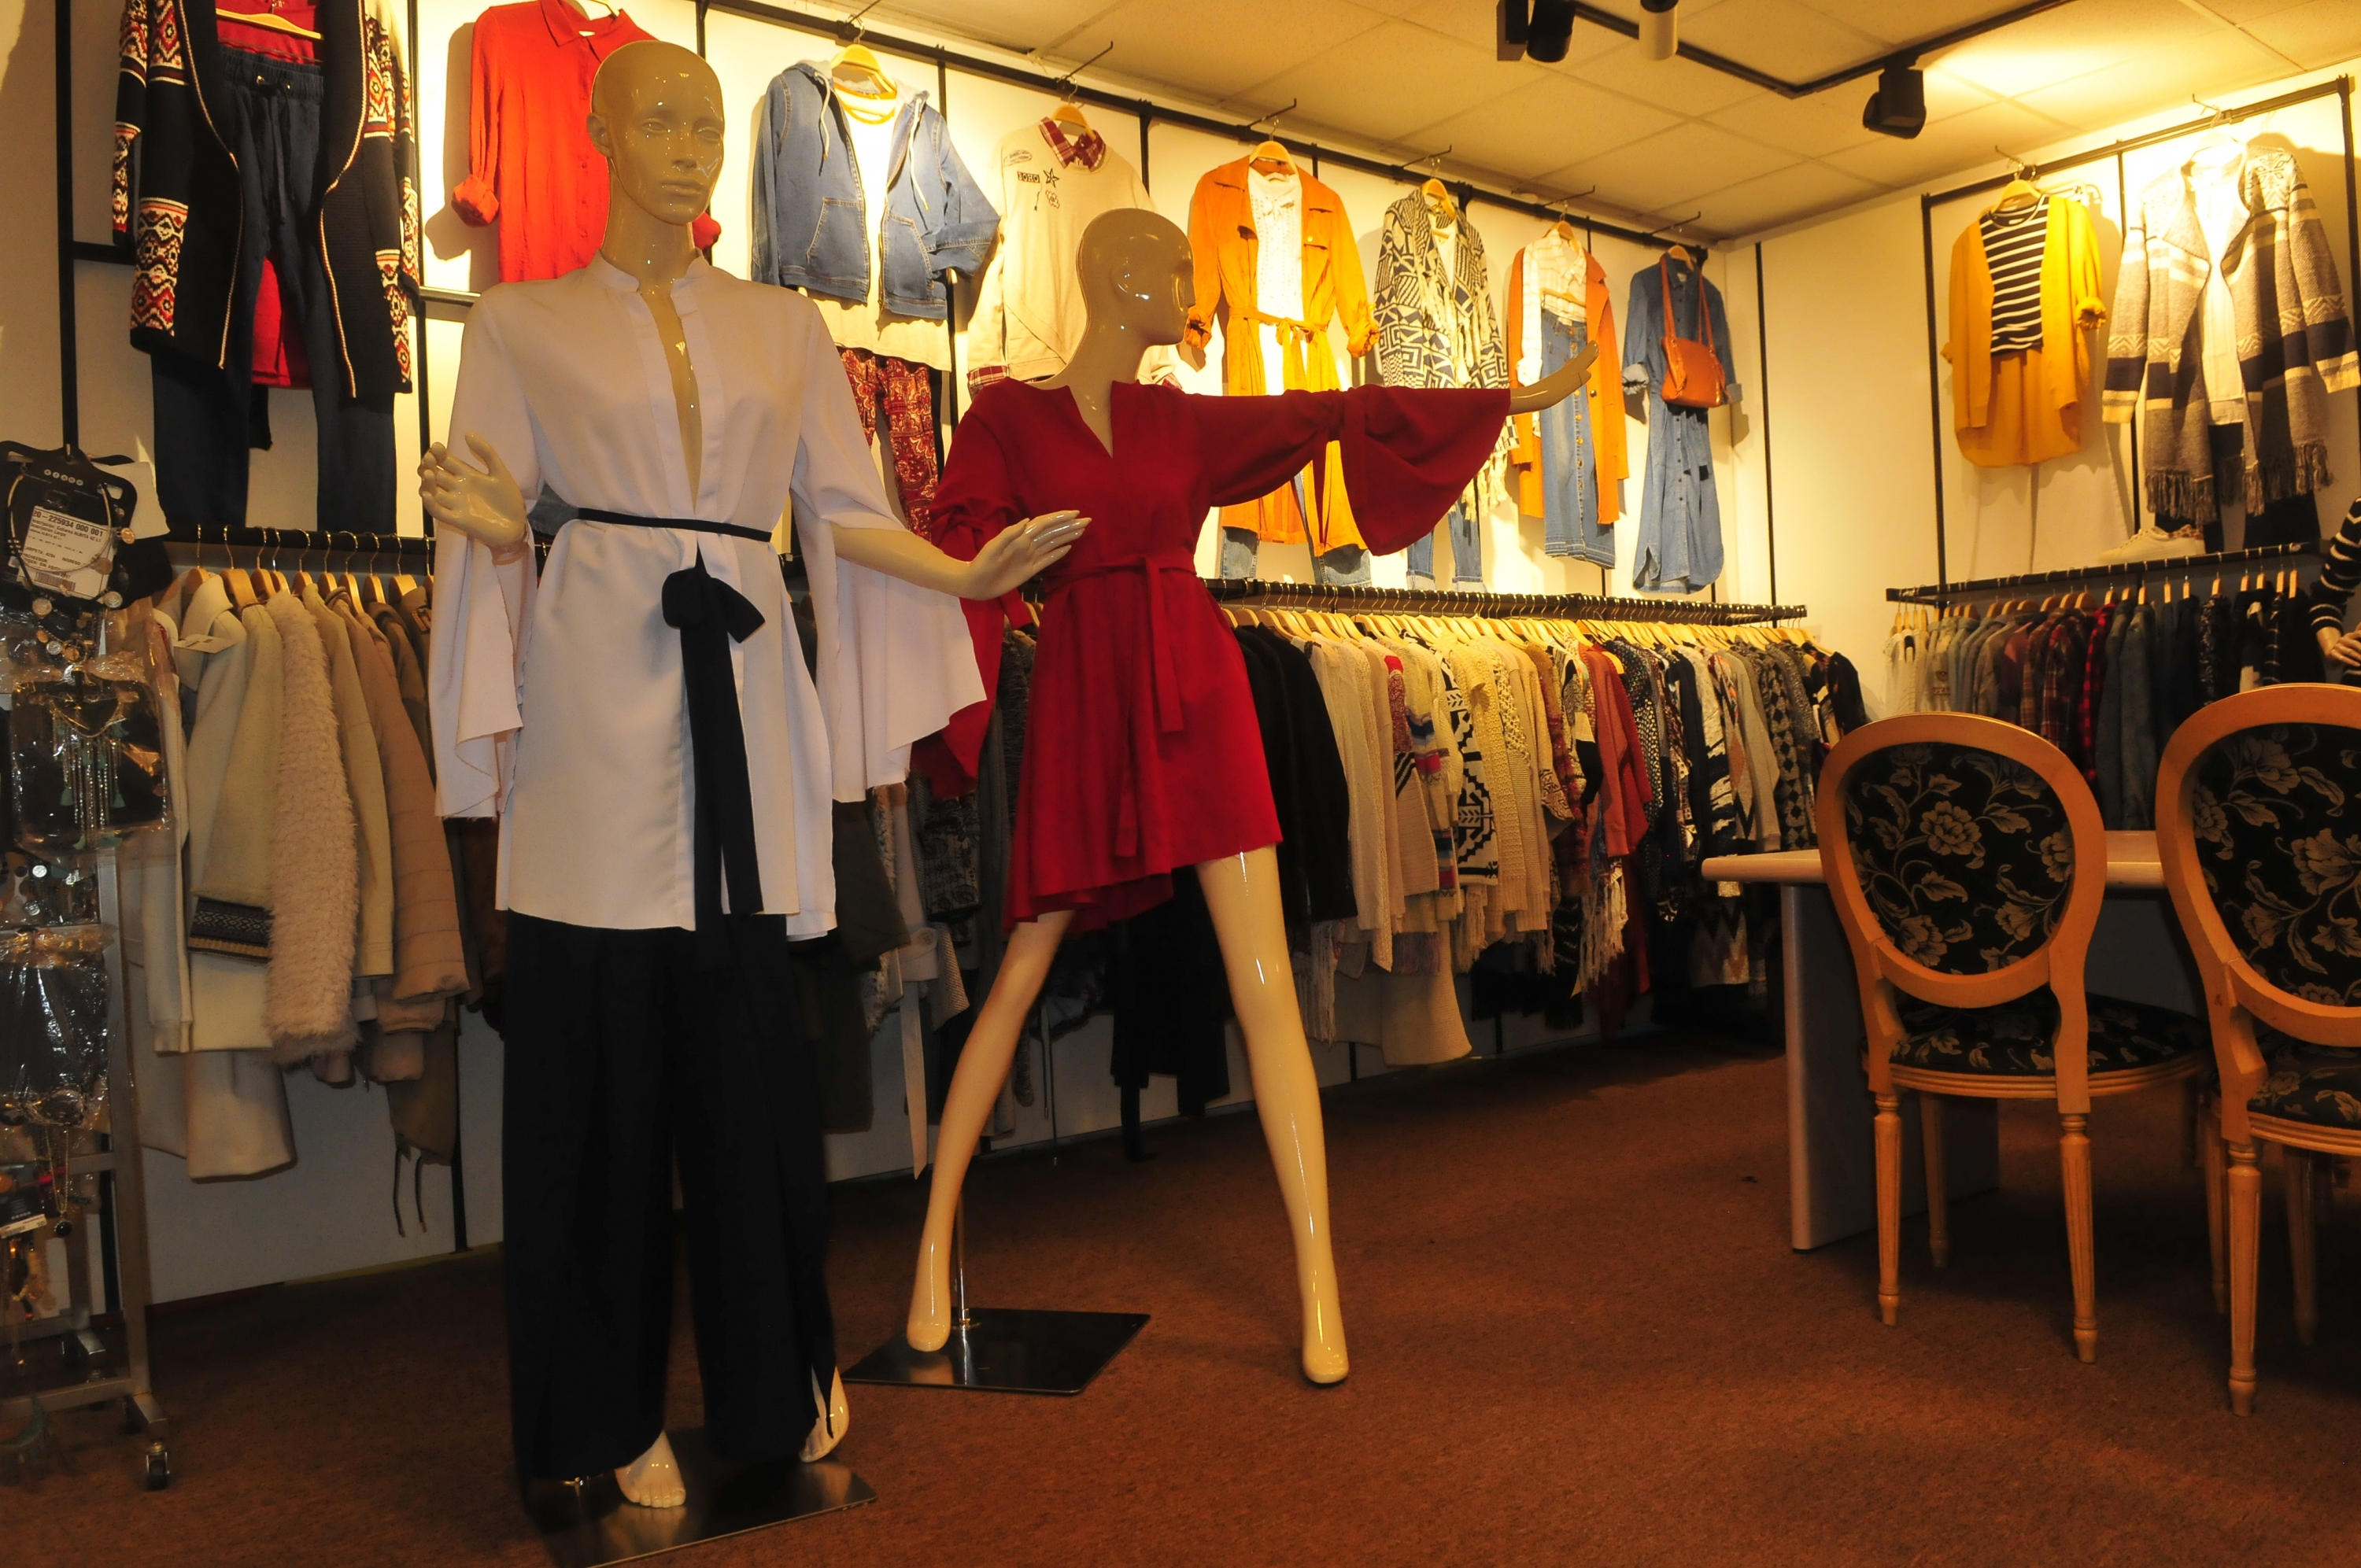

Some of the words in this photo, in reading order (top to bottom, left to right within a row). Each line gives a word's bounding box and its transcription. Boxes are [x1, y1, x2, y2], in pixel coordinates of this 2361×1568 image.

[49, 515, 74, 528] 225934
[76, 523, 89, 533] 000
[91, 528, 103, 537] 001
